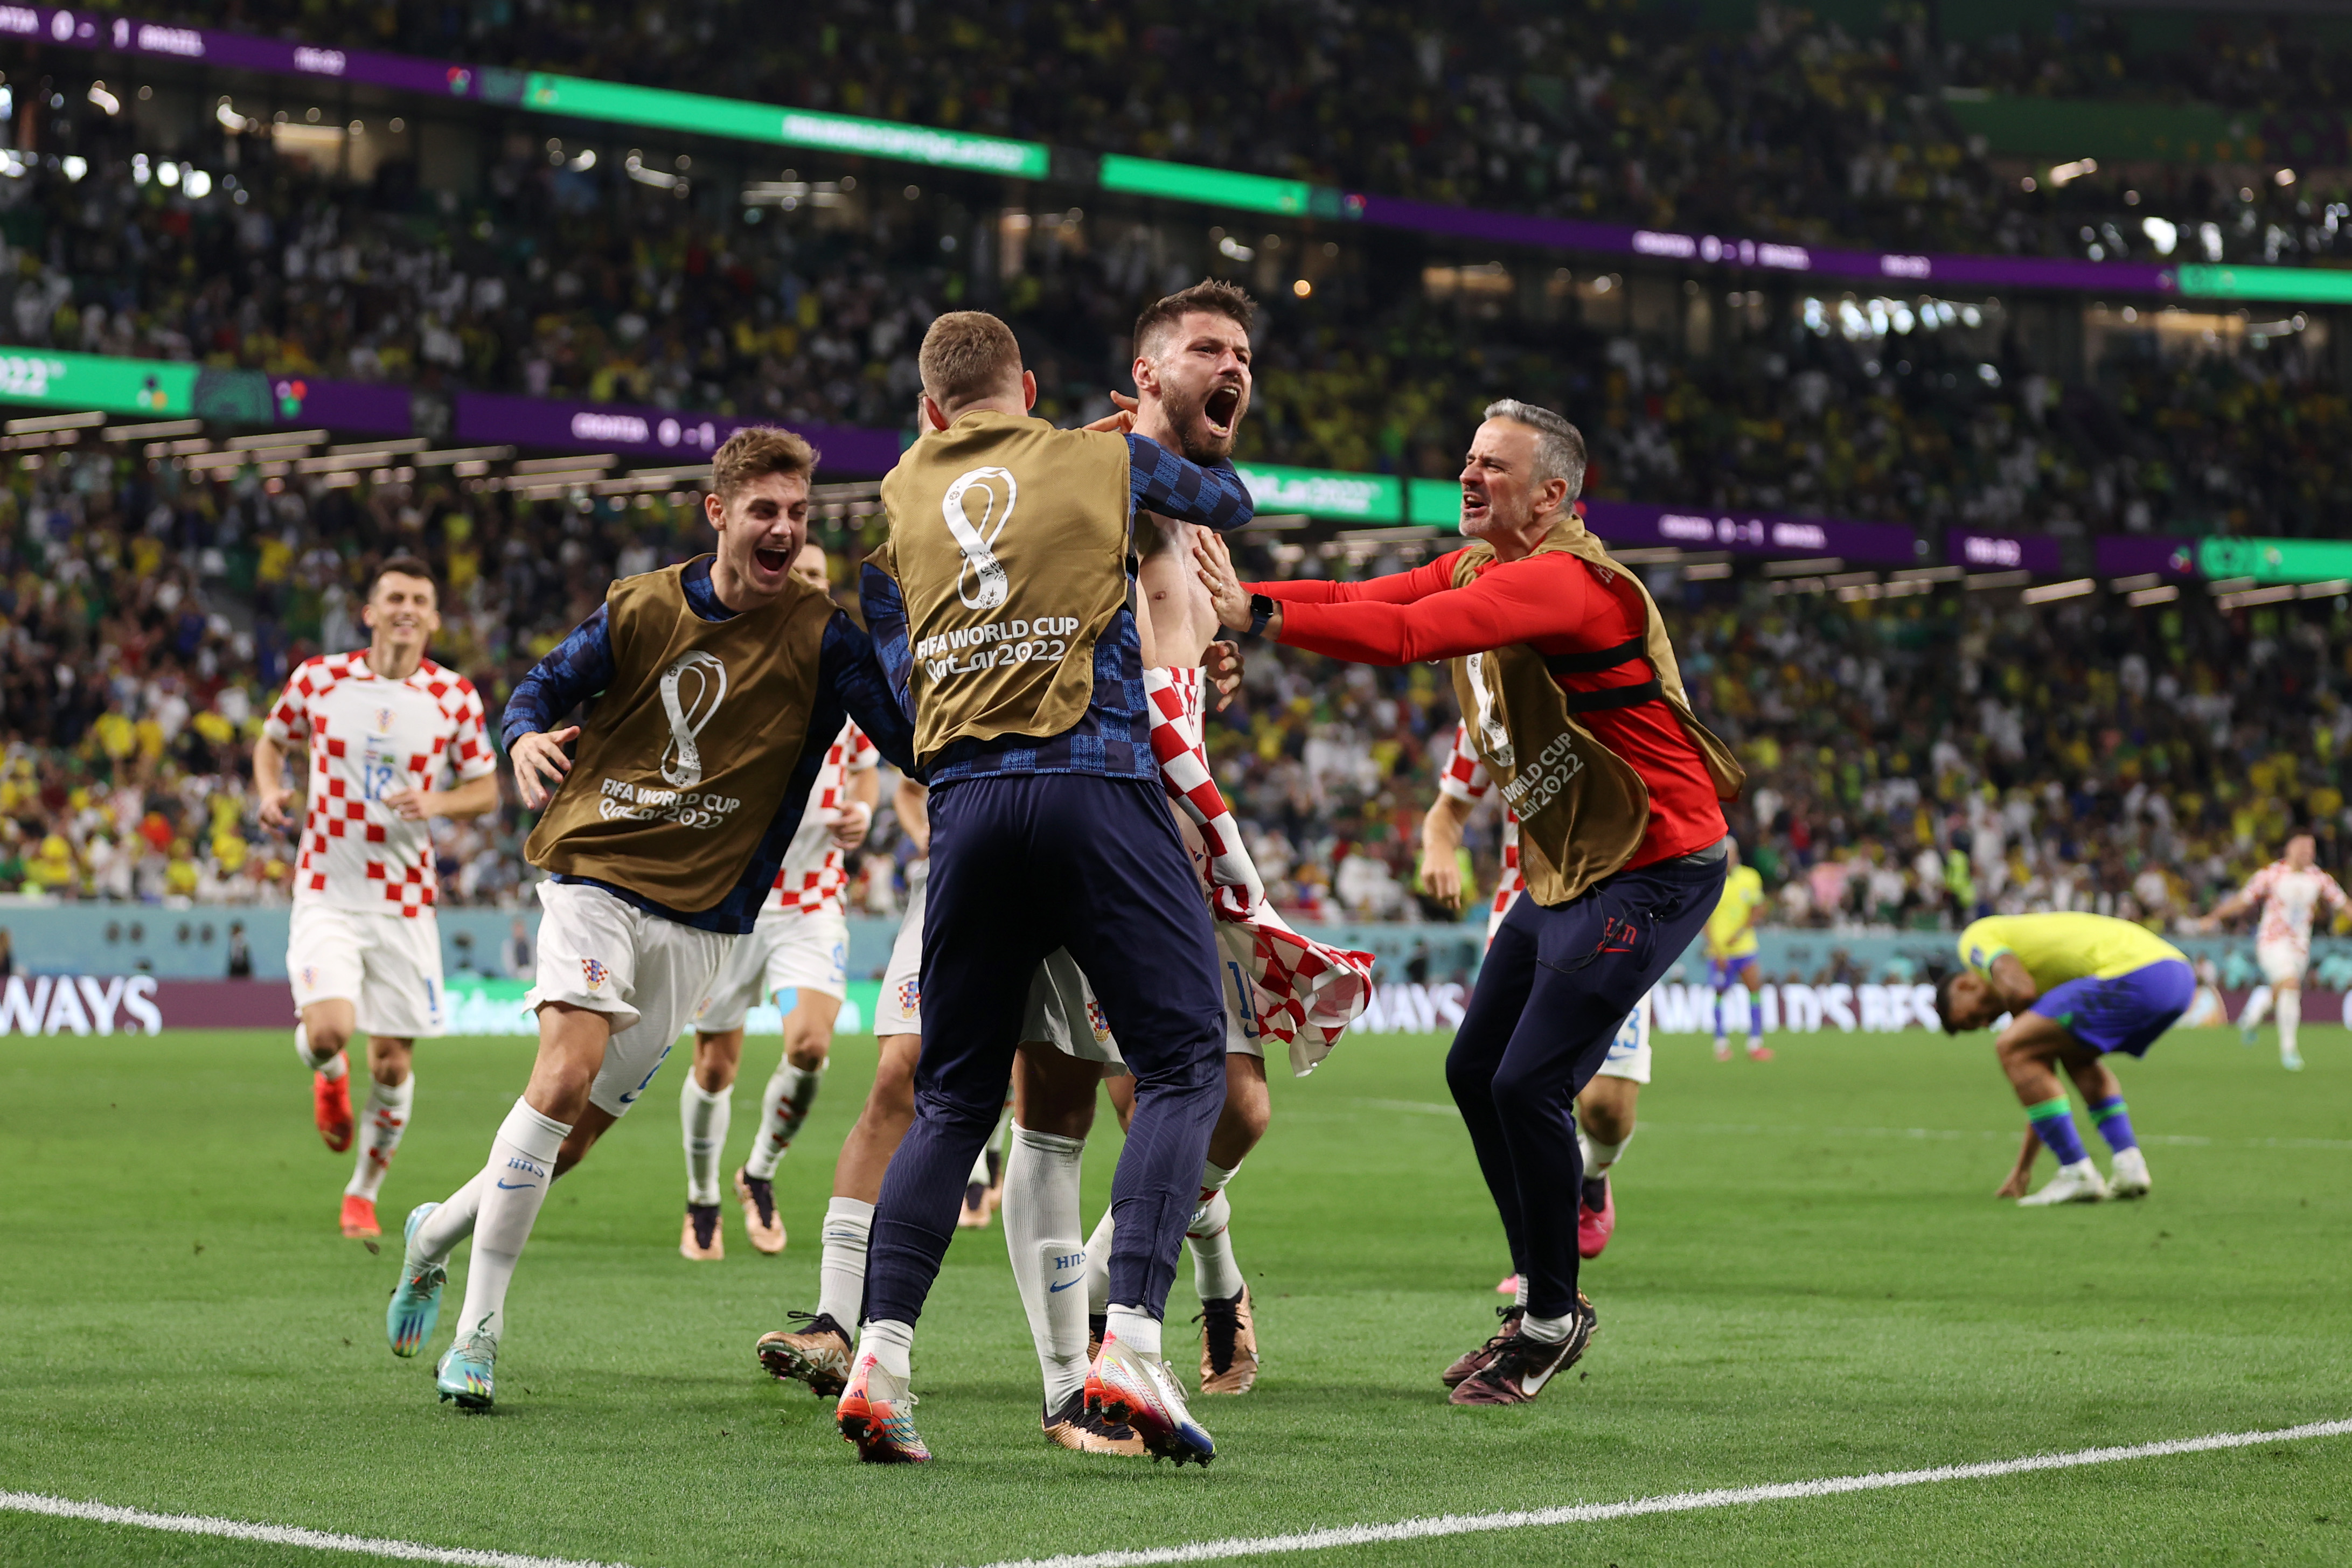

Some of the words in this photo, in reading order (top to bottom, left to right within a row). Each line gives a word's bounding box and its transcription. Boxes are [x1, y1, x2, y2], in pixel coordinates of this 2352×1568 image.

[917, 635, 948, 660] FIFA
[949, 619, 1029, 649] WORLD
[1033, 617, 1079, 636] CUP
[365, 764, 393, 801] 12
[1501, 763, 1543, 803] WORLD
[1540, 732, 1572, 766] CUP
[600, 778, 634, 802] FIFA
[636, 788, 700, 807] WORLD
[703, 793, 741, 814] CUP
[0, 974, 163, 1037] WAYS
[1612, 1006, 1640, 1049] 3
